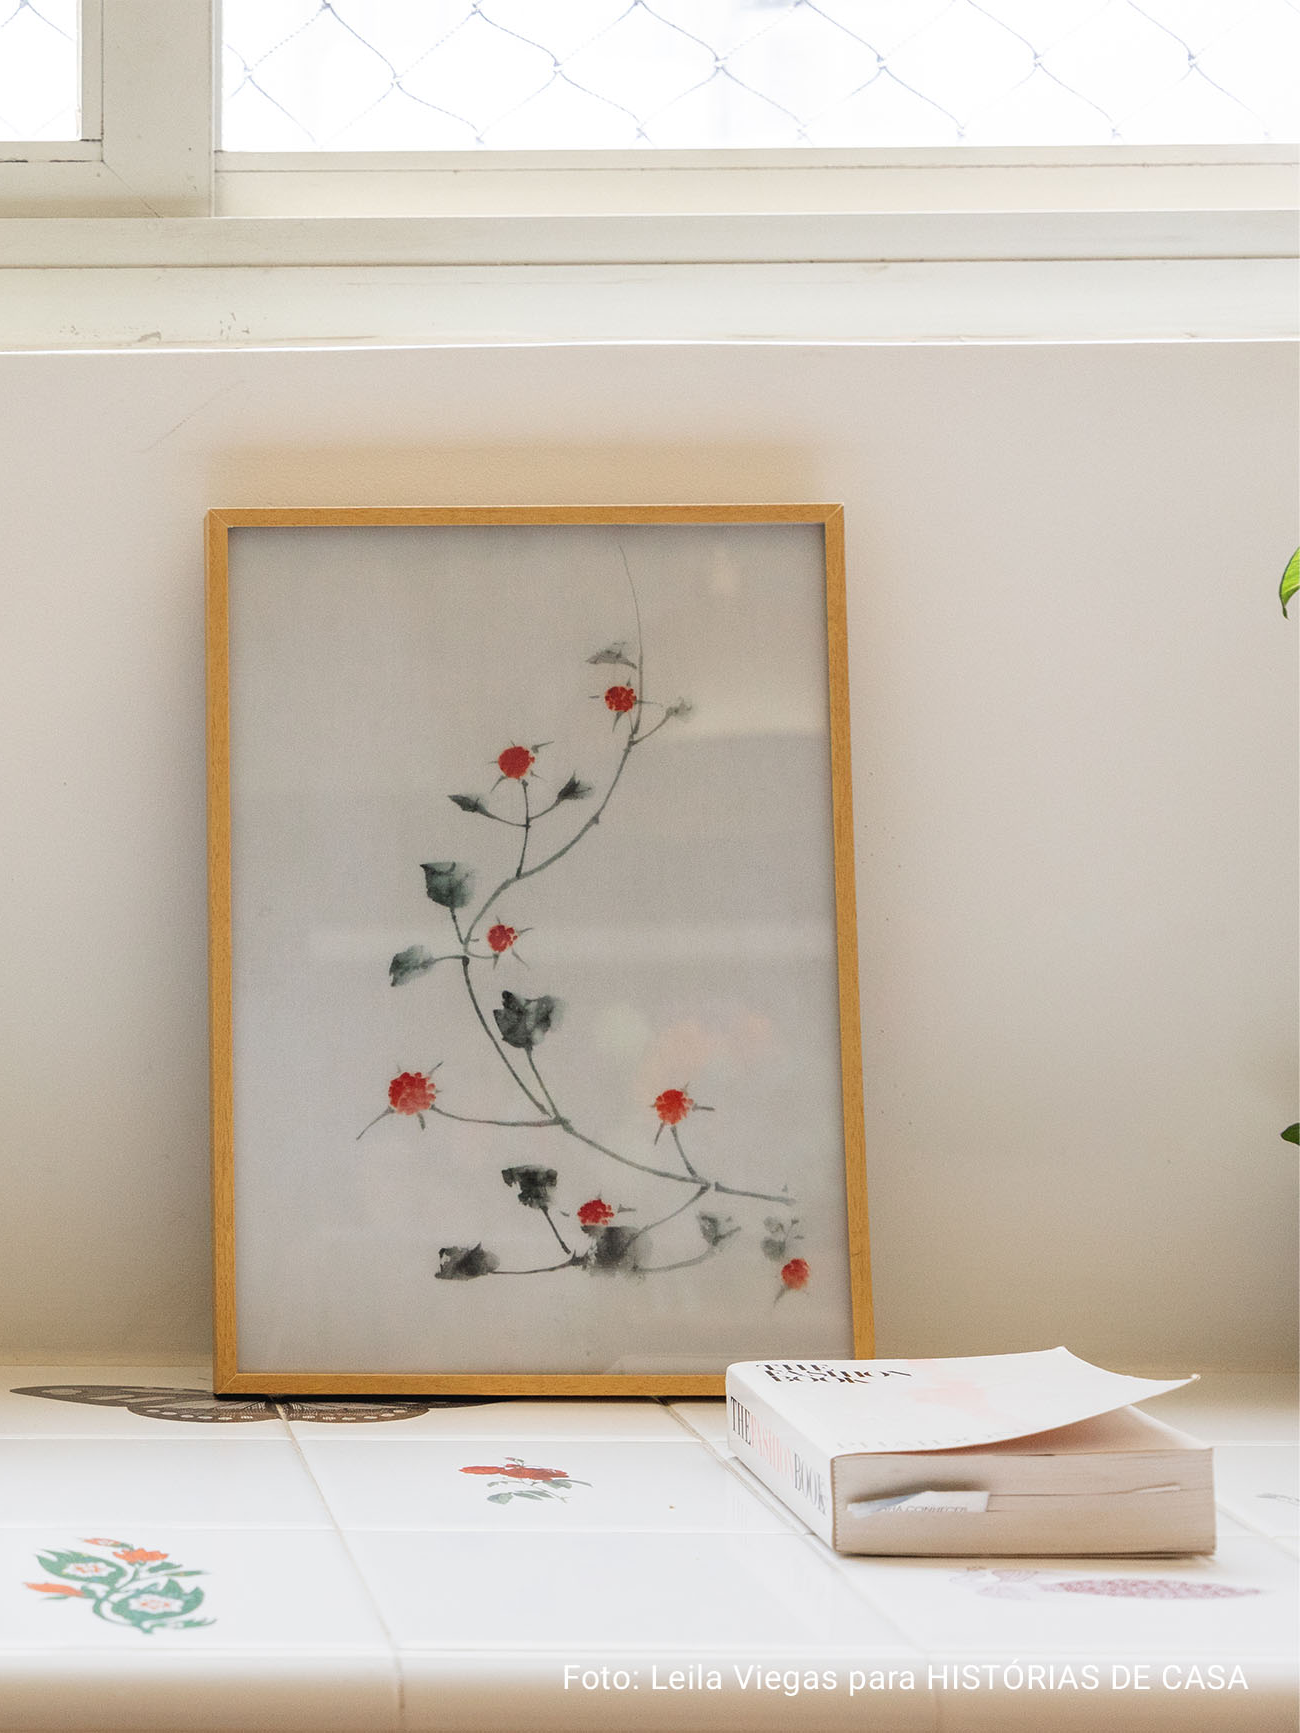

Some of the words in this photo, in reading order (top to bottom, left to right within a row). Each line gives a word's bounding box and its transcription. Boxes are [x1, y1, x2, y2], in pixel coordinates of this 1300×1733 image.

[755, 1363, 828, 1371] THE
[730, 1395, 751, 1446] THE
[794, 1451, 827, 1516] BOOK
